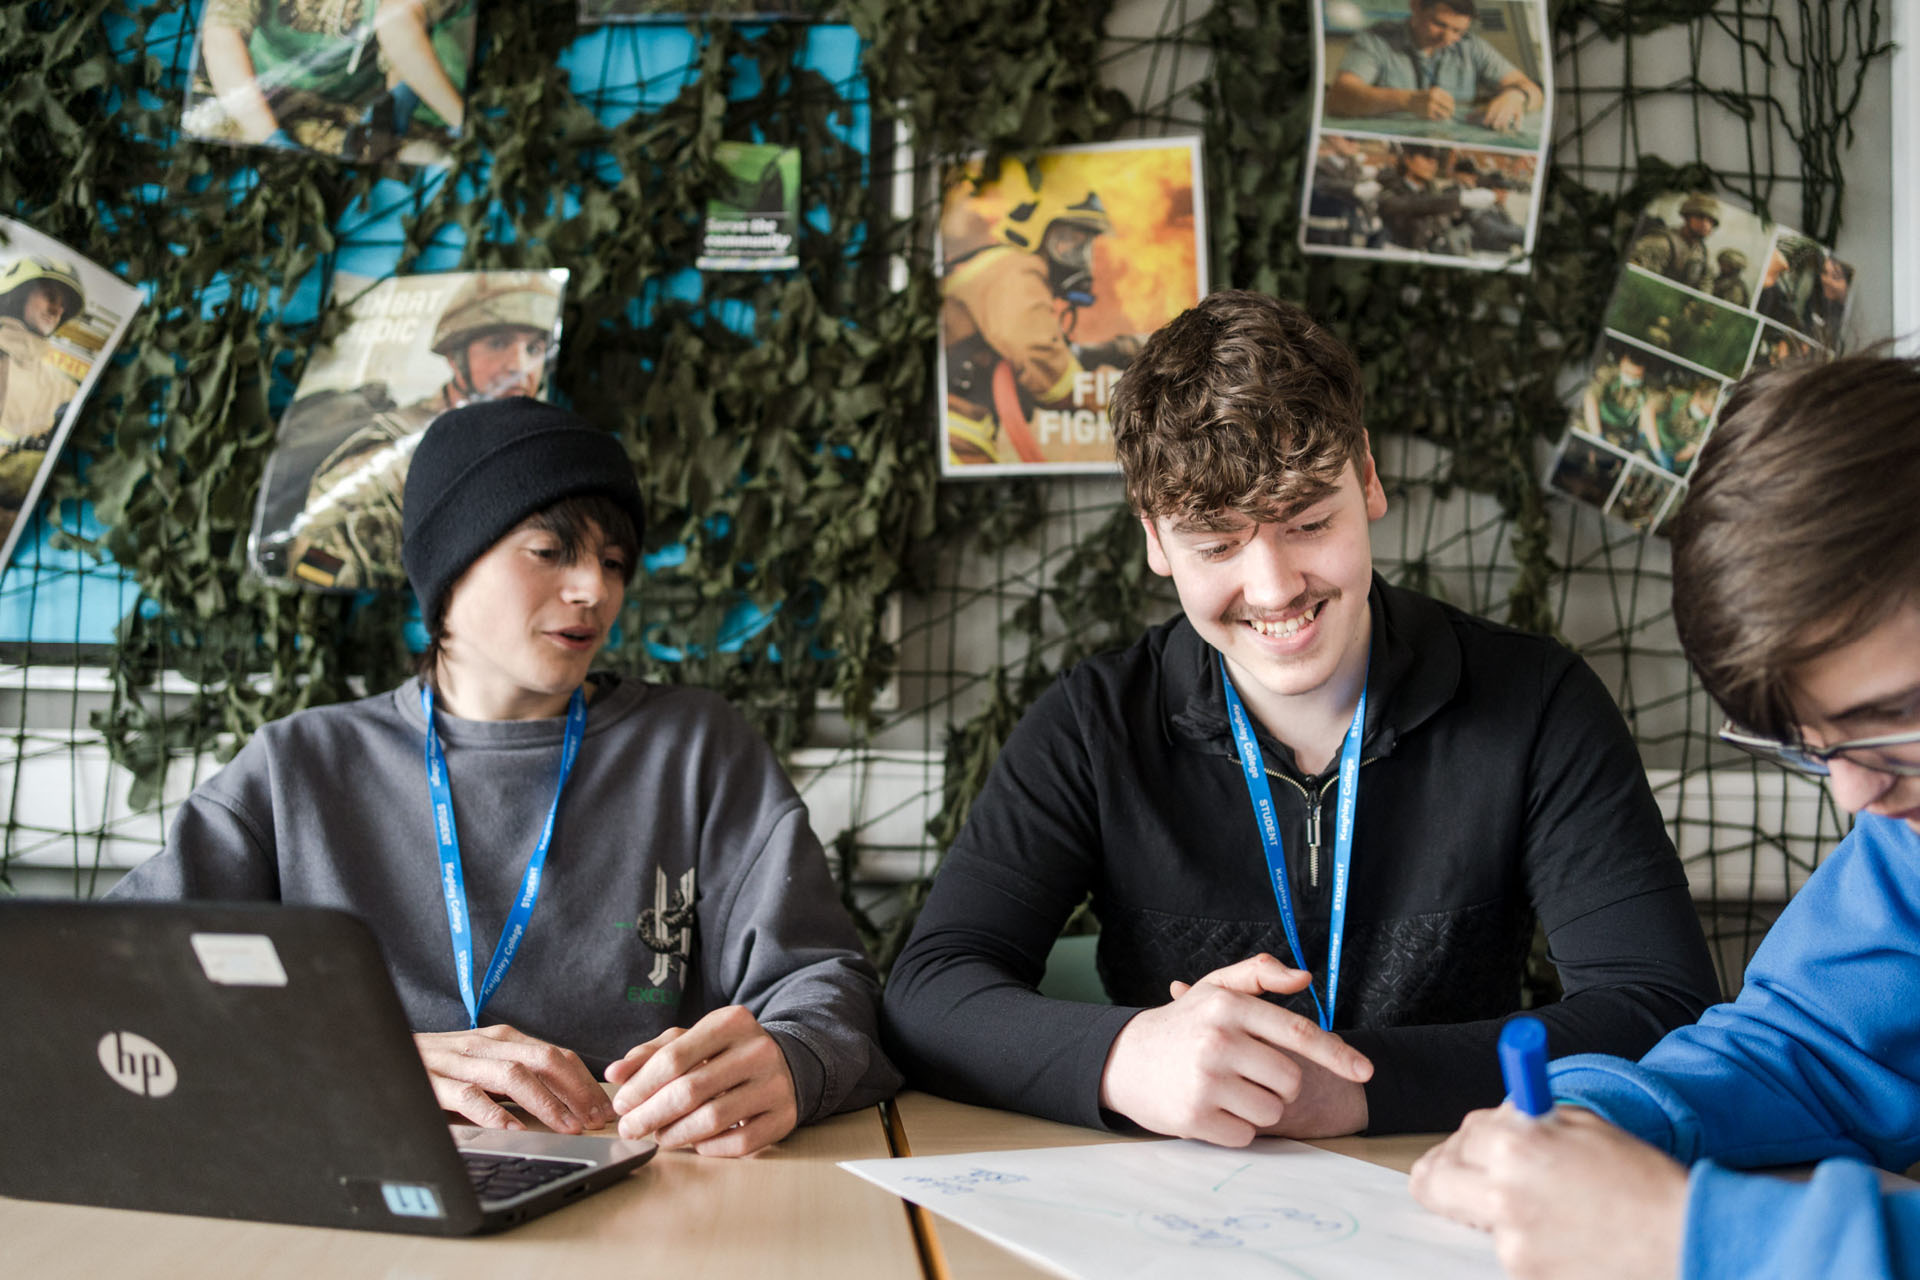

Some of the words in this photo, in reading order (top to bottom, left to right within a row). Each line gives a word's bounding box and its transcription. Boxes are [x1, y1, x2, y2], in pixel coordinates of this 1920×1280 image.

[703, 233, 792, 250] community
[1233, 703, 1249, 742] Keighley
[1243, 741, 1259, 779] College
[1343, 757, 1356, 797] College
[436, 803, 453, 846] STUDENT
[1258, 798, 1279, 847] STUDENT
[1339, 794, 1353, 842] Keighley
[445, 861, 458, 900] Keighley
[520, 866, 539, 910] STUDENT
[1274, 867, 1290, 911] Keighley
[1334, 862, 1346, 912] STUDENT
[450, 898, 463, 935] College
[483, 956, 510, 996] Keighley
[503, 923, 523, 957] College
[1329, 932, 1339, 971] College
[113, 1030, 164, 1098] hp
